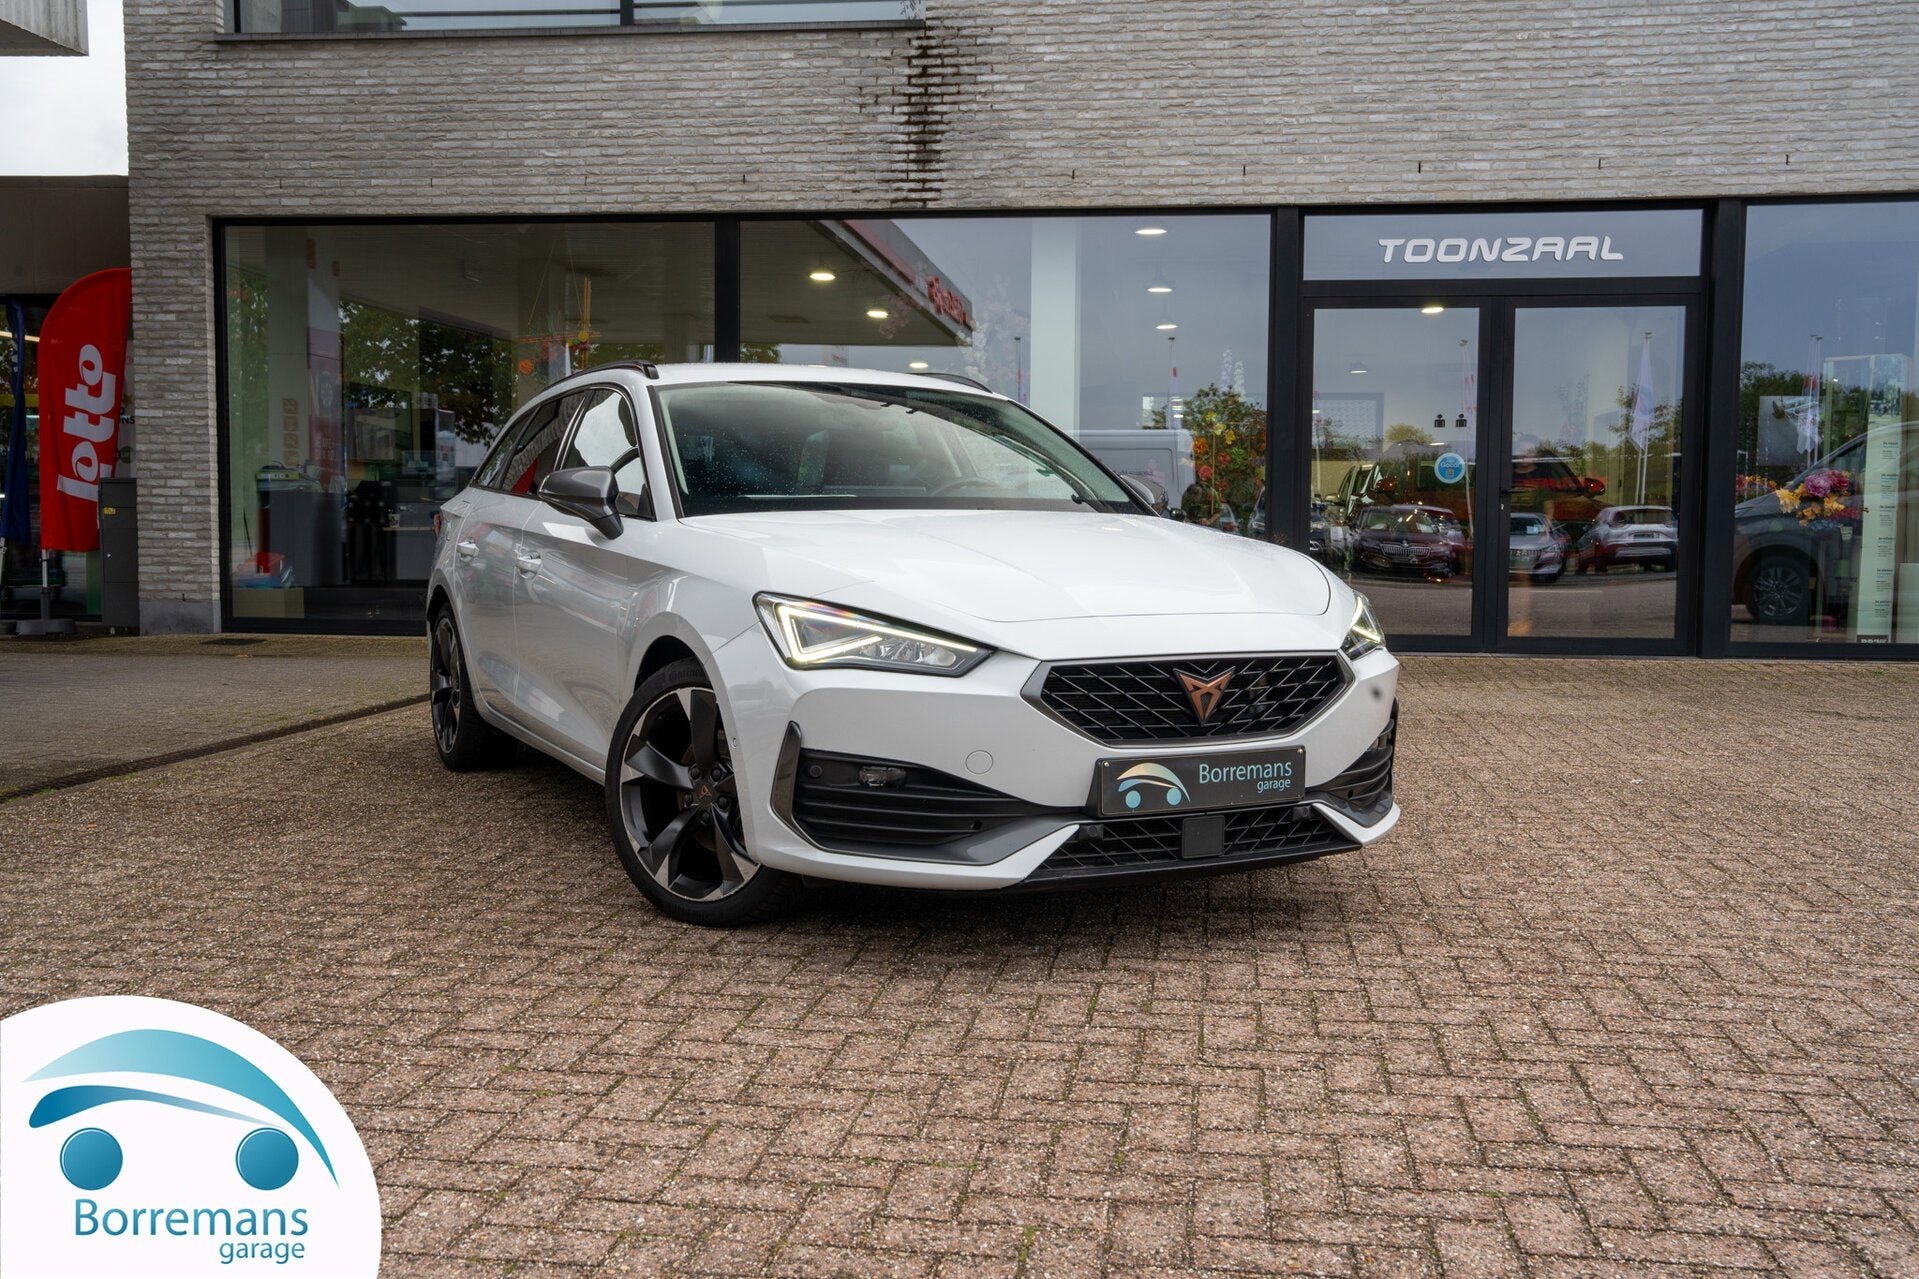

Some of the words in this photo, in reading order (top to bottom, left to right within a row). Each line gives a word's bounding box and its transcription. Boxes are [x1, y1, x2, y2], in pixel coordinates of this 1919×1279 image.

[1378, 236, 1624, 263] TOONZAAL
[57, 343, 117, 502] lotto
[1199, 761, 1293, 784] Borremans
[1257, 779, 1291, 794] garage
